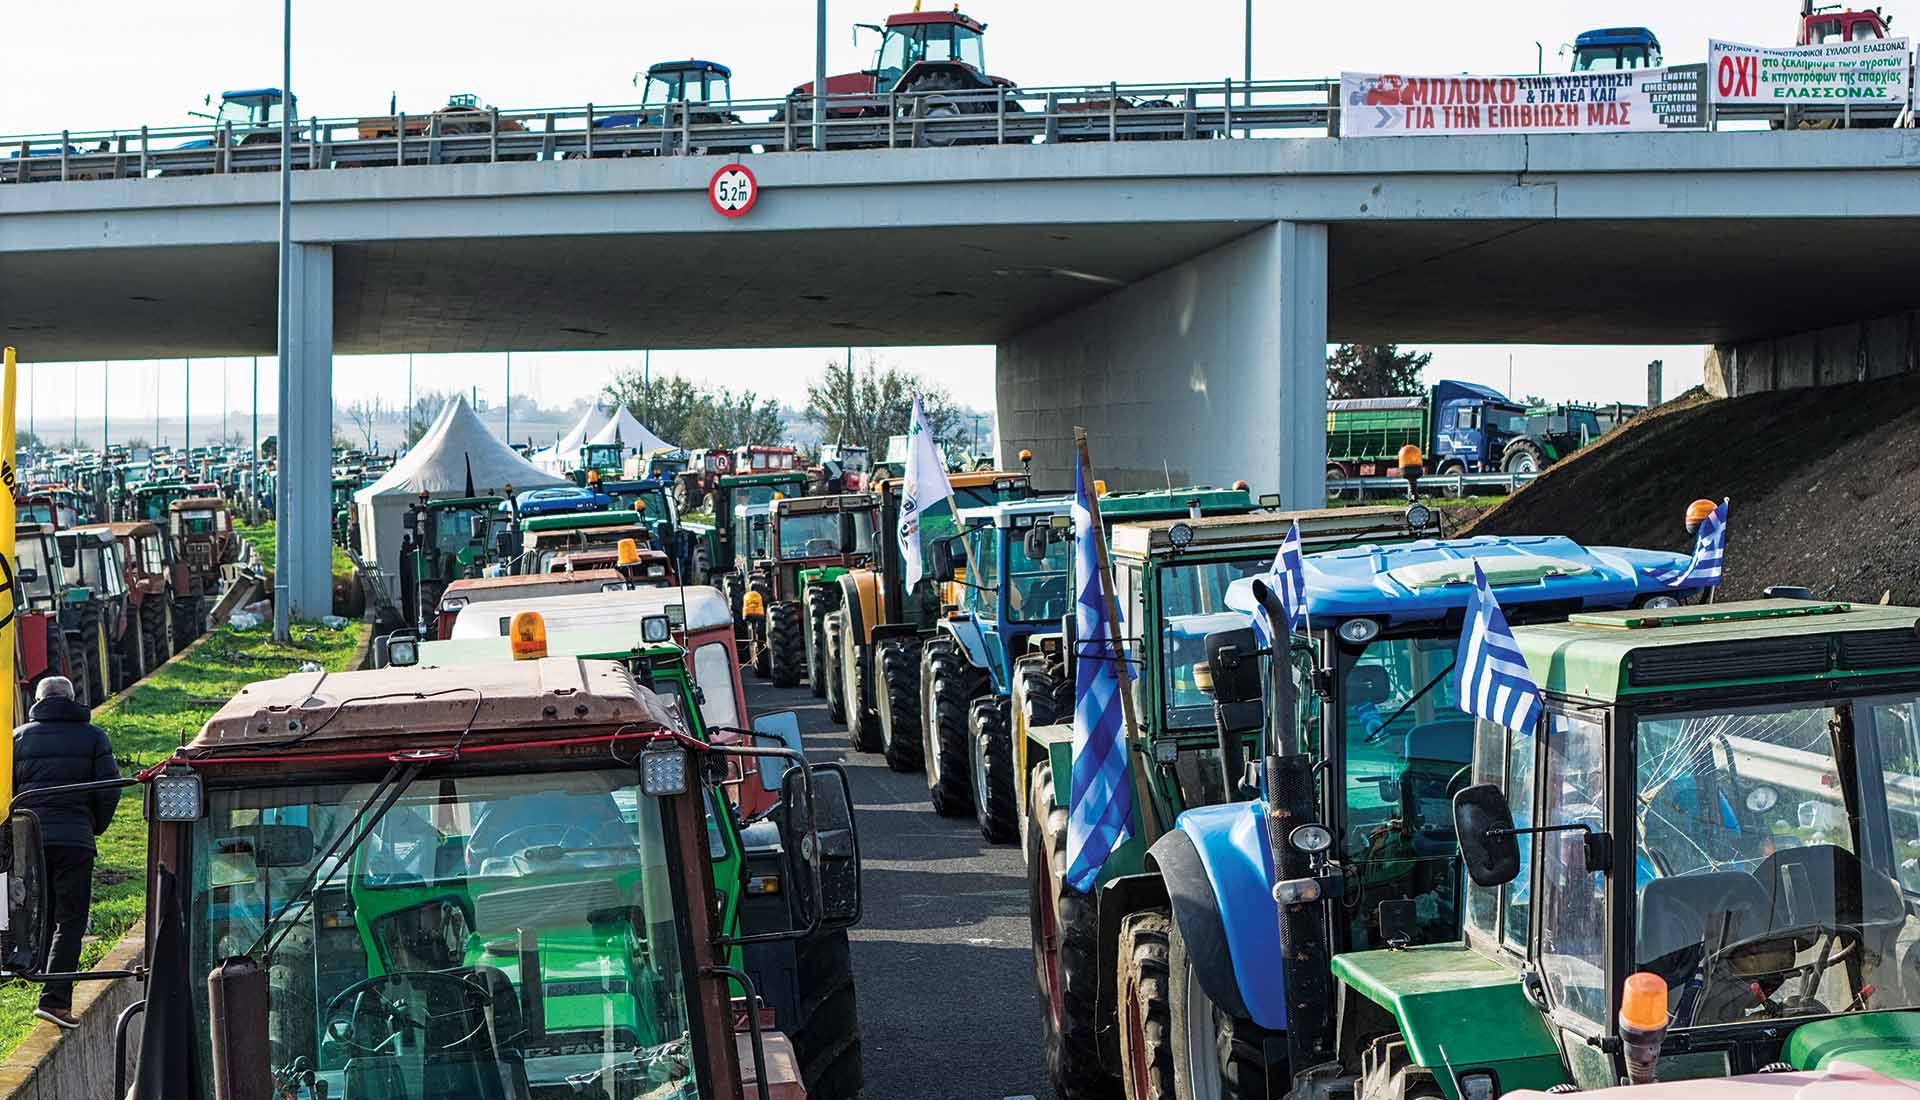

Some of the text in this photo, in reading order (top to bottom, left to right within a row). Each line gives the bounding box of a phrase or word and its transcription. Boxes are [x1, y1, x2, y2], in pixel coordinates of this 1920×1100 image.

[1826, 46, 1860, 56] ΣΥΛΛΟΓΟΙ
[1863, 41, 1906, 53] ΕΛΑΣΣΟΝΑΣ
[1762, 58, 1779, 68] στο
[1860, 55, 1902, 70] αγροτών
[1517, 73, 1632, 89] ΣΤΗΝ ΚΥΒΕΡΝΗΣΗ
[1718, 55, 1758, 97] ΟΧΙ
[1761, 69, 1901, 85] & κτηνοτρόφων της επαρχίας
[1403, 78, 1516, 105] ΜΠΛΟΚΟ
[1526, 87, 1617, 103] & ΤΗ ΝΕΑ ΚΑΠ
[1653, 93, 1697, 102] ΑΓΡΟΤΙΚΩΝ
[1773, 87, 1888, 97] ΕΛΑΣΣΟΝΑΣ
[1405, 102, 1631, 128] ΓΙΑ ΤΗΝ ΕΠΙΒΙΩΣΗ ΜΑΣ
[719, 181, 738, 202] 5.2
